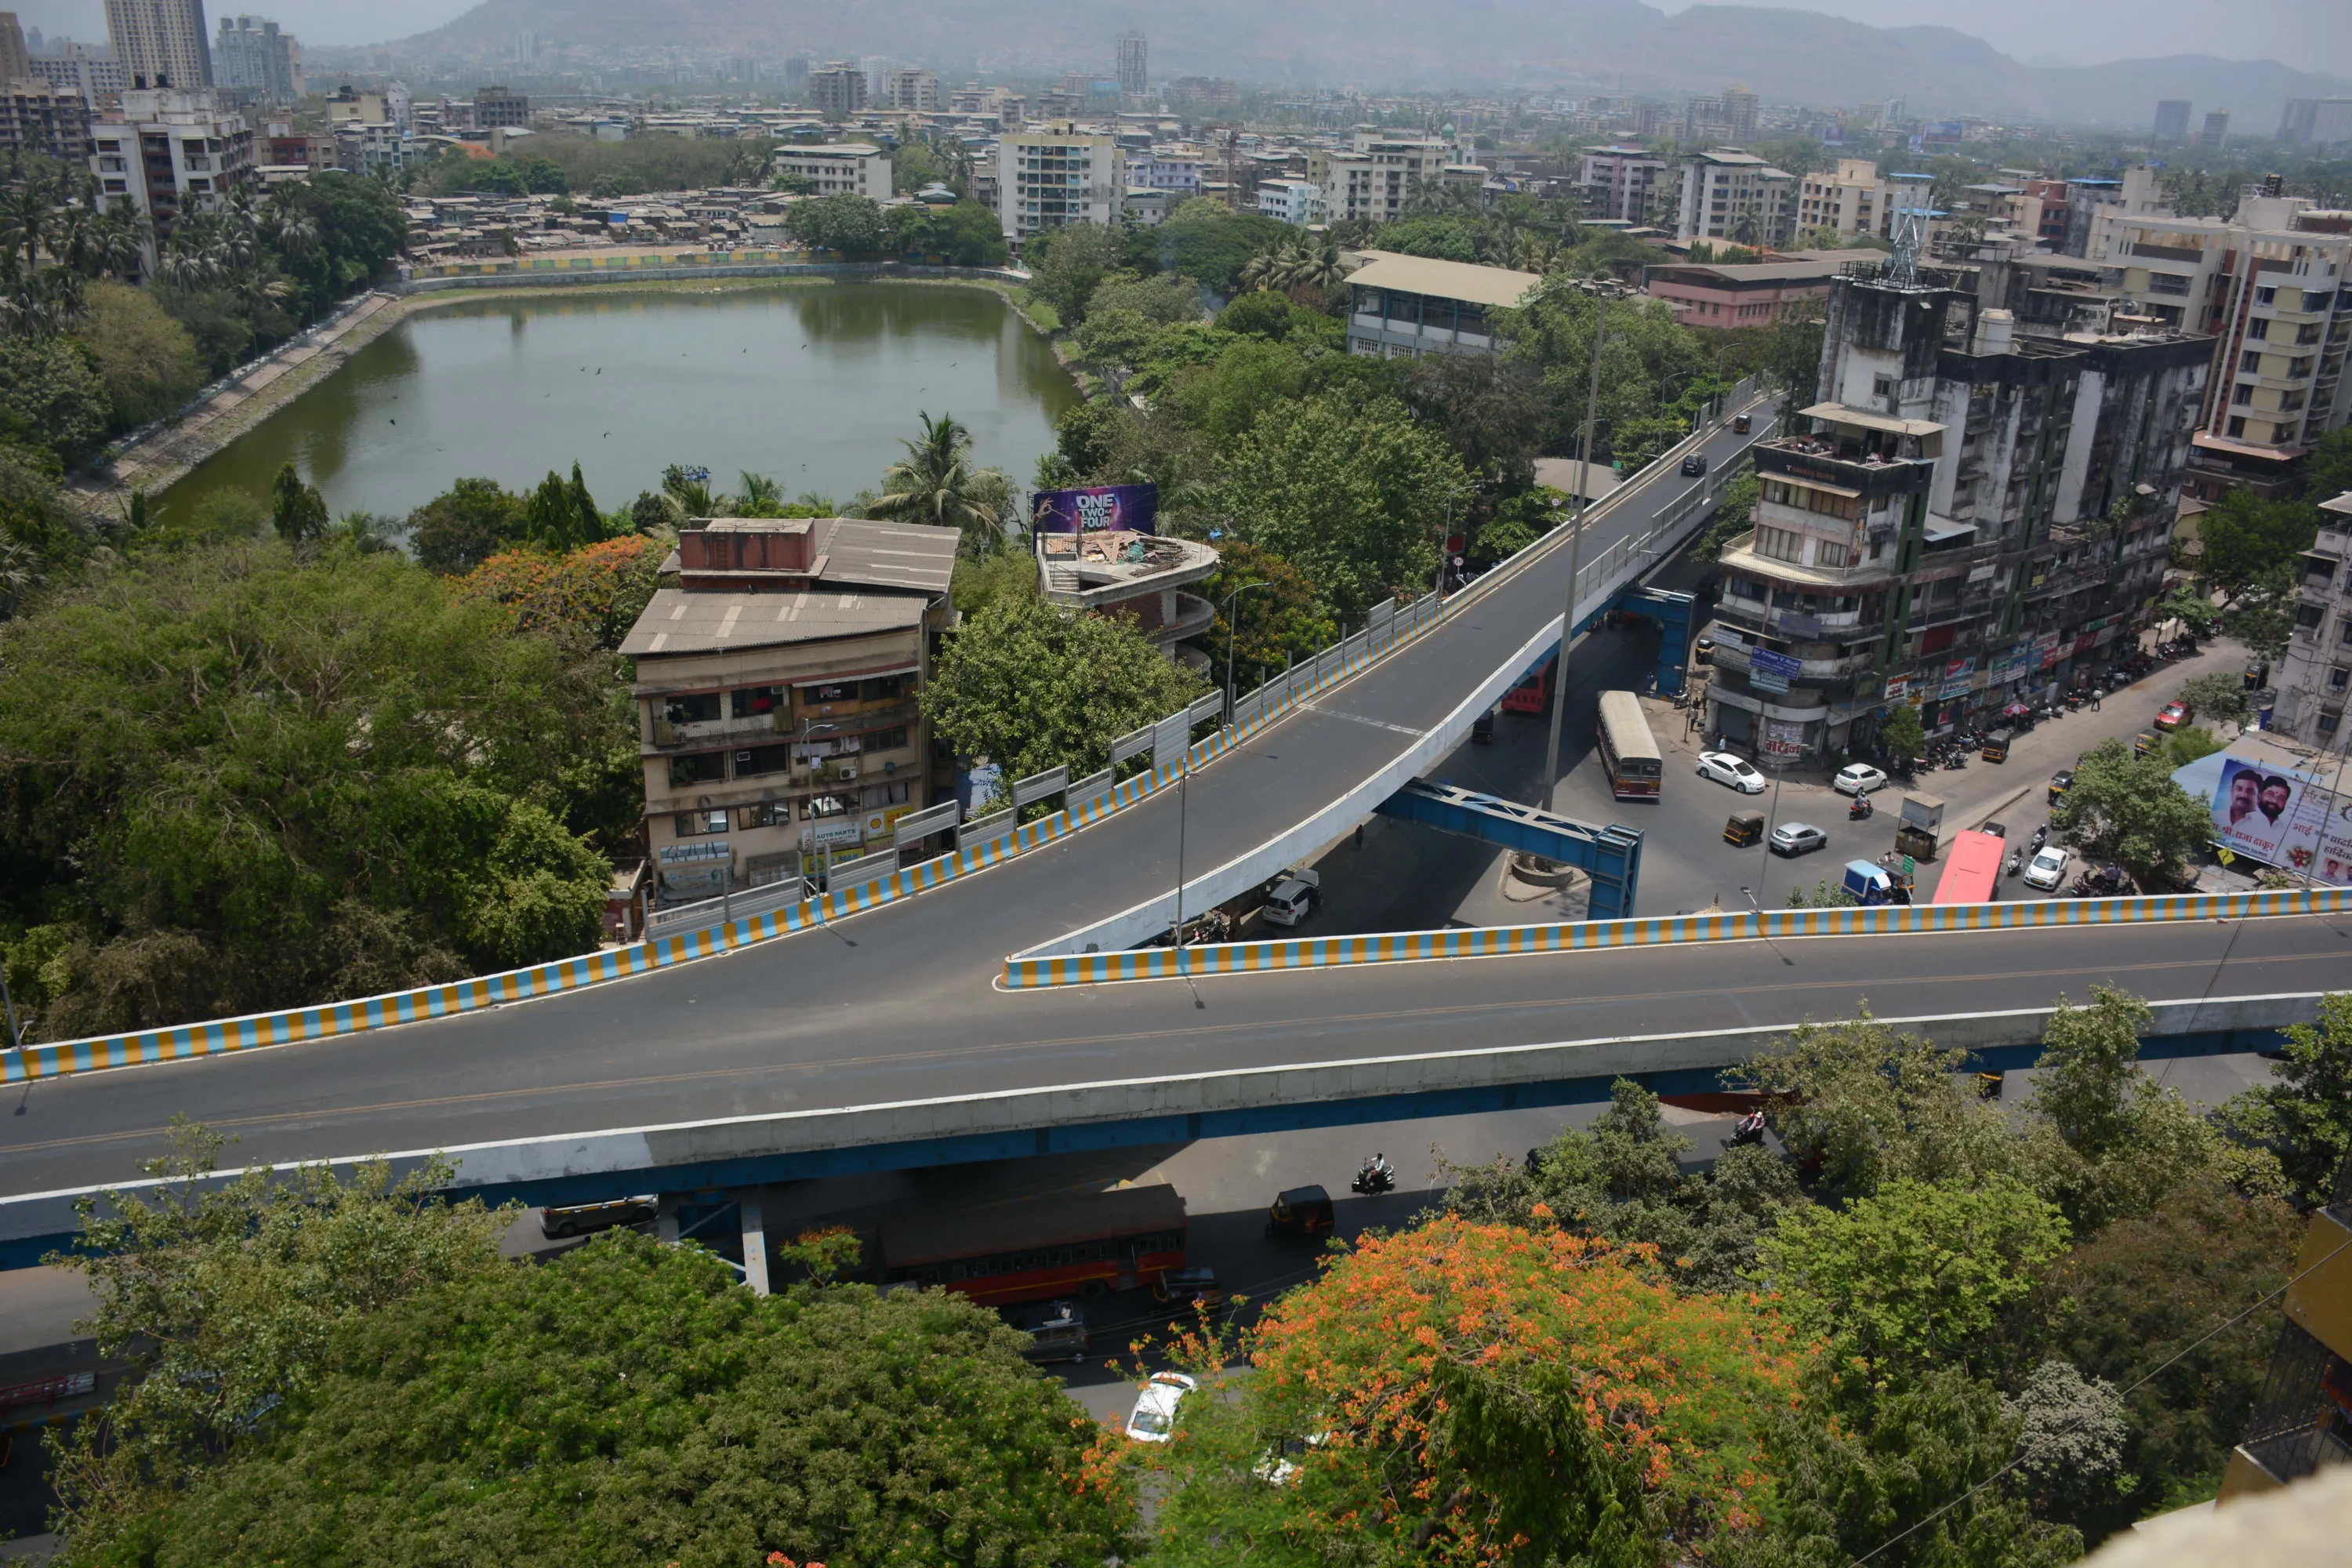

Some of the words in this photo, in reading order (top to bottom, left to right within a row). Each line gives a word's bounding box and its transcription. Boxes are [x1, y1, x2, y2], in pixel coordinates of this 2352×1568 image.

[1076, 493, 1114, 509] ONE
[1078, 507, 1105, 517] TWO
[1081, 516, 1110, 528] FOUR
[1761, 651, 1778, 661] Pritam
[834, 829, 856, 837] PARTS
